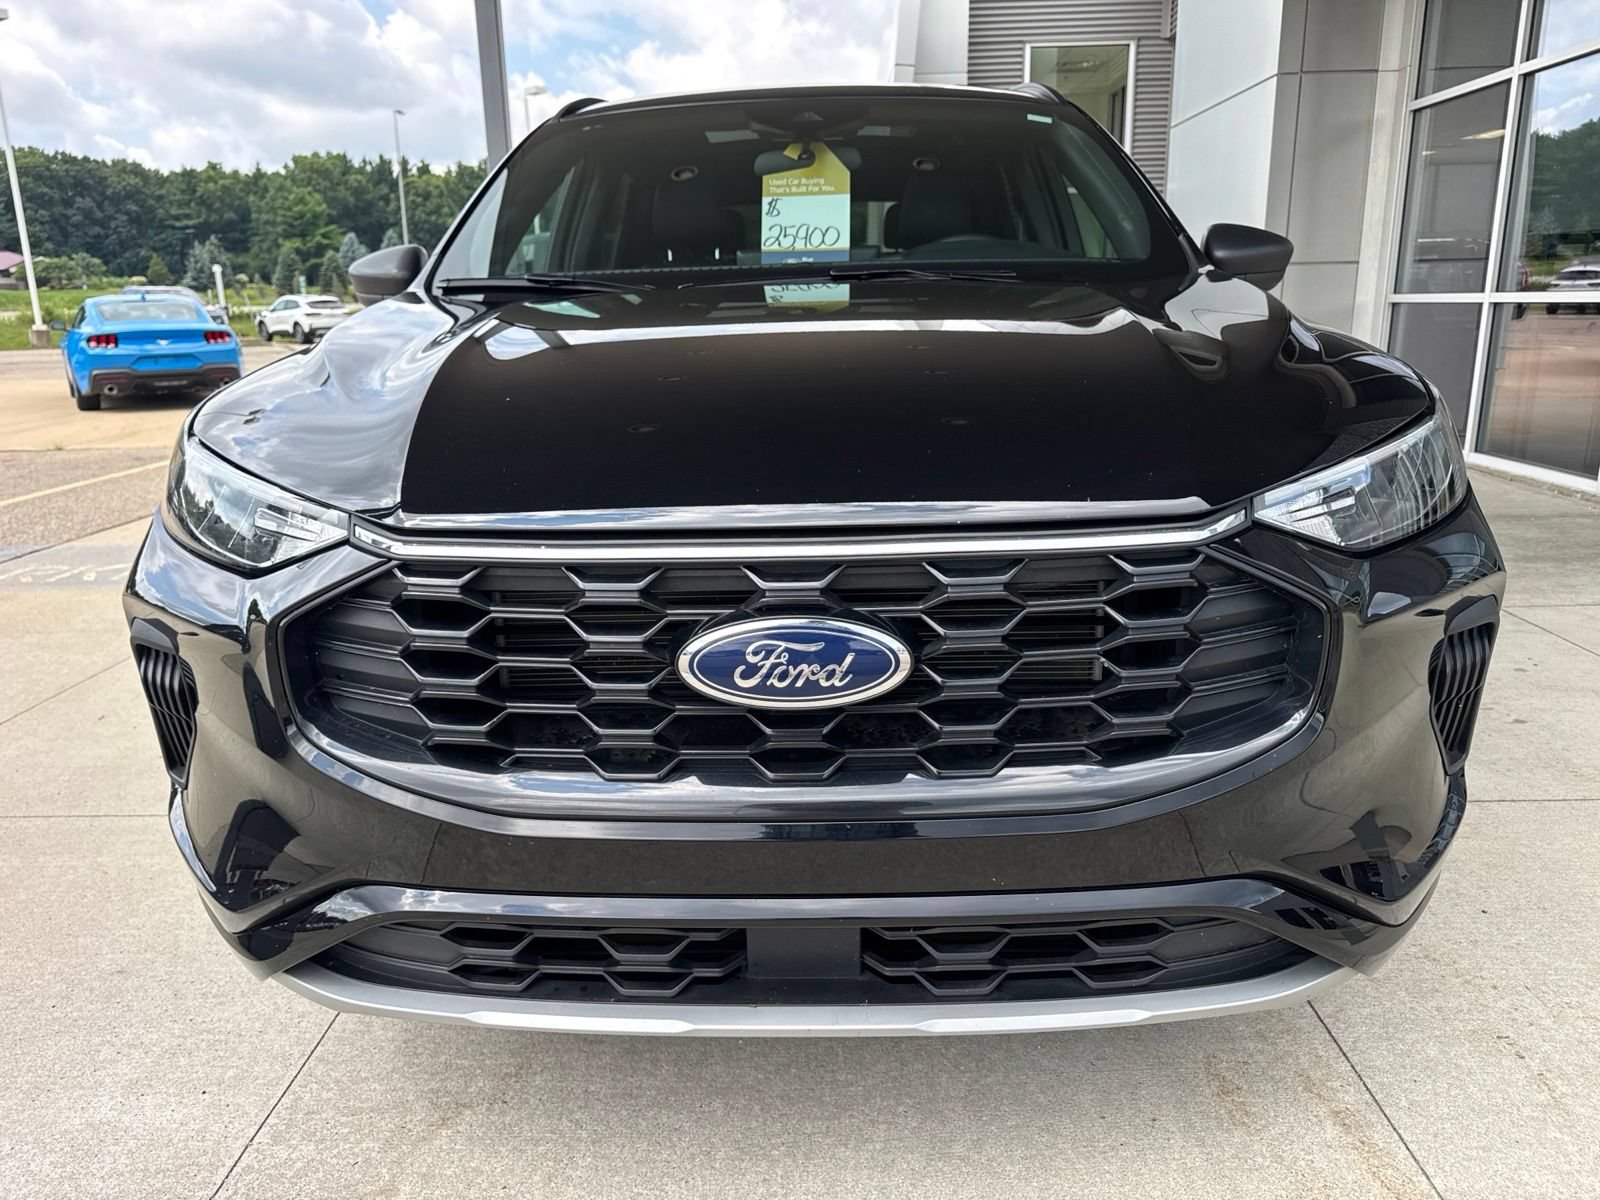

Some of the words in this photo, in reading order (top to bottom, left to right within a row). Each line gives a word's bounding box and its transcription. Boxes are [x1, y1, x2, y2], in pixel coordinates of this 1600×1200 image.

[769, 178, 787, 186] Used
[801, 177, 825, 186] Buying
[769, 186, 791, 194] That's
[791, 185, 808, 193] Built
[765, 197, 782, 217] $
[733, 640, 855, 688] Ford
